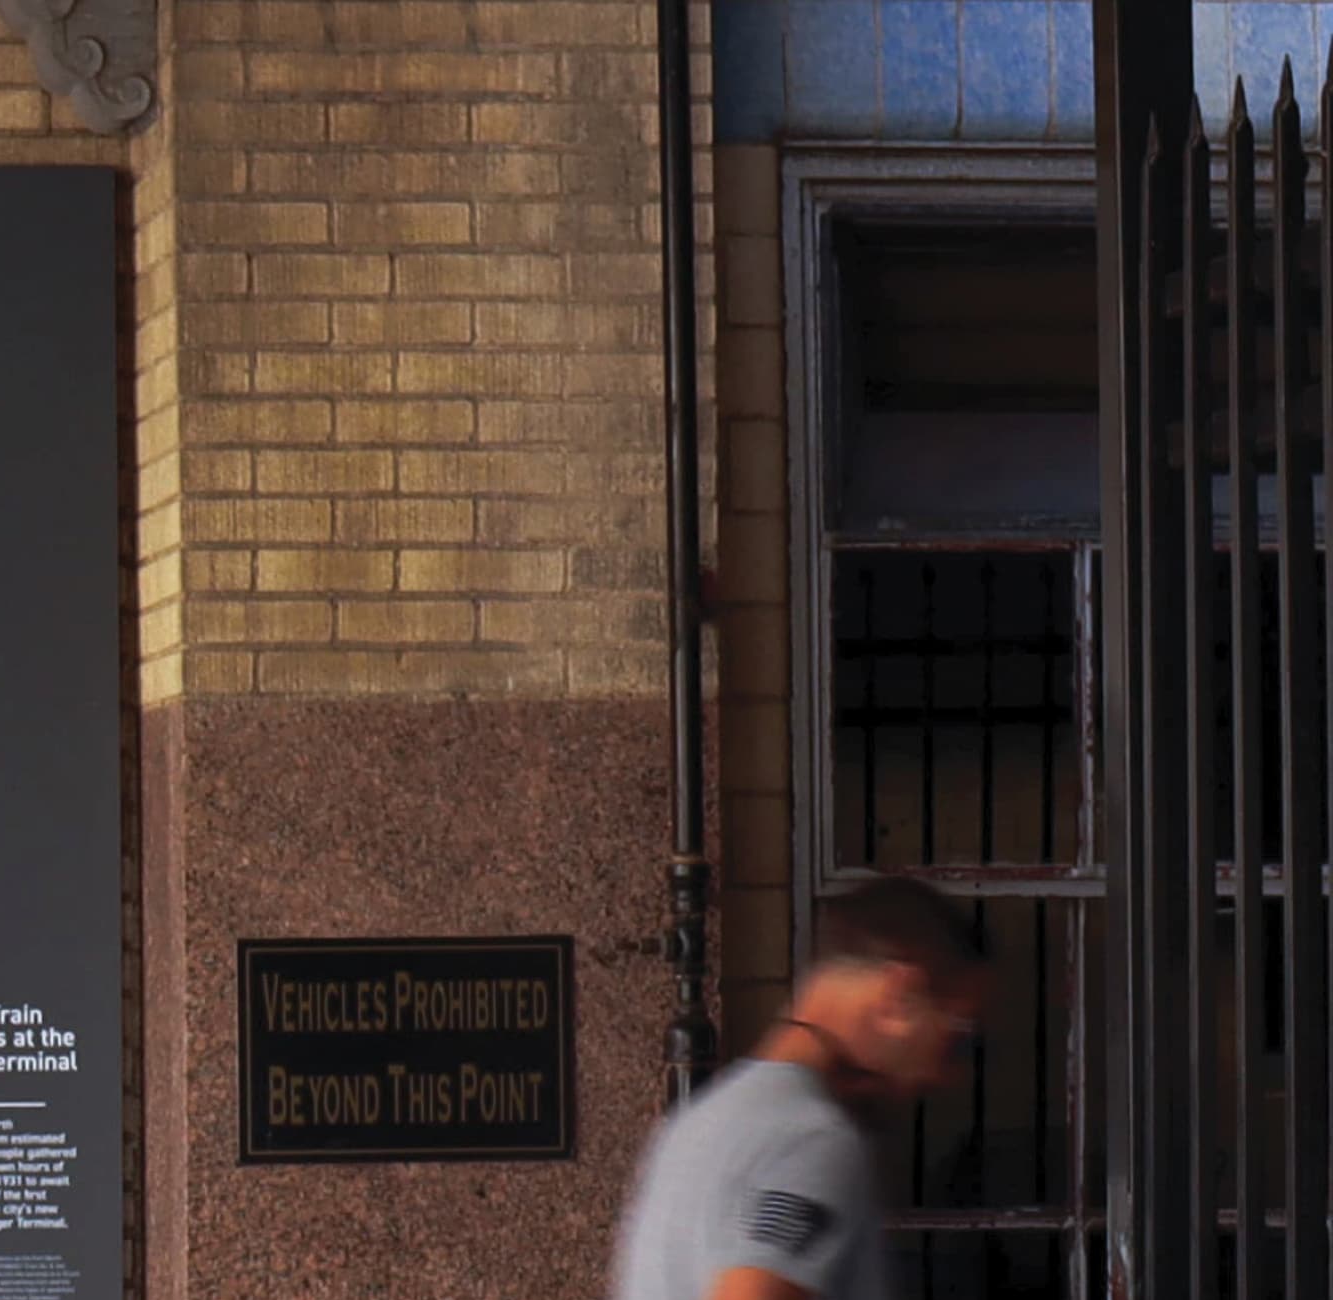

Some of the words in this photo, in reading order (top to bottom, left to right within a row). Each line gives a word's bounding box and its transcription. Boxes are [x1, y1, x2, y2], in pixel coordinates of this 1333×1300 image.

[262, 972, 387, 1032] VEHICLES
[394, 971, 548, 1031] PROHIBITED
[13, 1029, 34, 1047] at
[41, 1027, 75, 1047] the
[269, 1065, 379, 1126] BEYOND
[388, 1064, 452, 1125] THIS
[461, 1063, 544, 1123] POINT
[11, 1131, 65, 1145] estimated
[27, 1146, 77, 1161] gathered
[18, 1160, 50, 1173] hours
[52, 1160, 64, 1173] of
[25, 1175, 37, 1187] to
[3, 1189, 21, 1201] the
[35, 1204, 59, 1215] new
[17, 1216, 69, 1230] Terminal.
